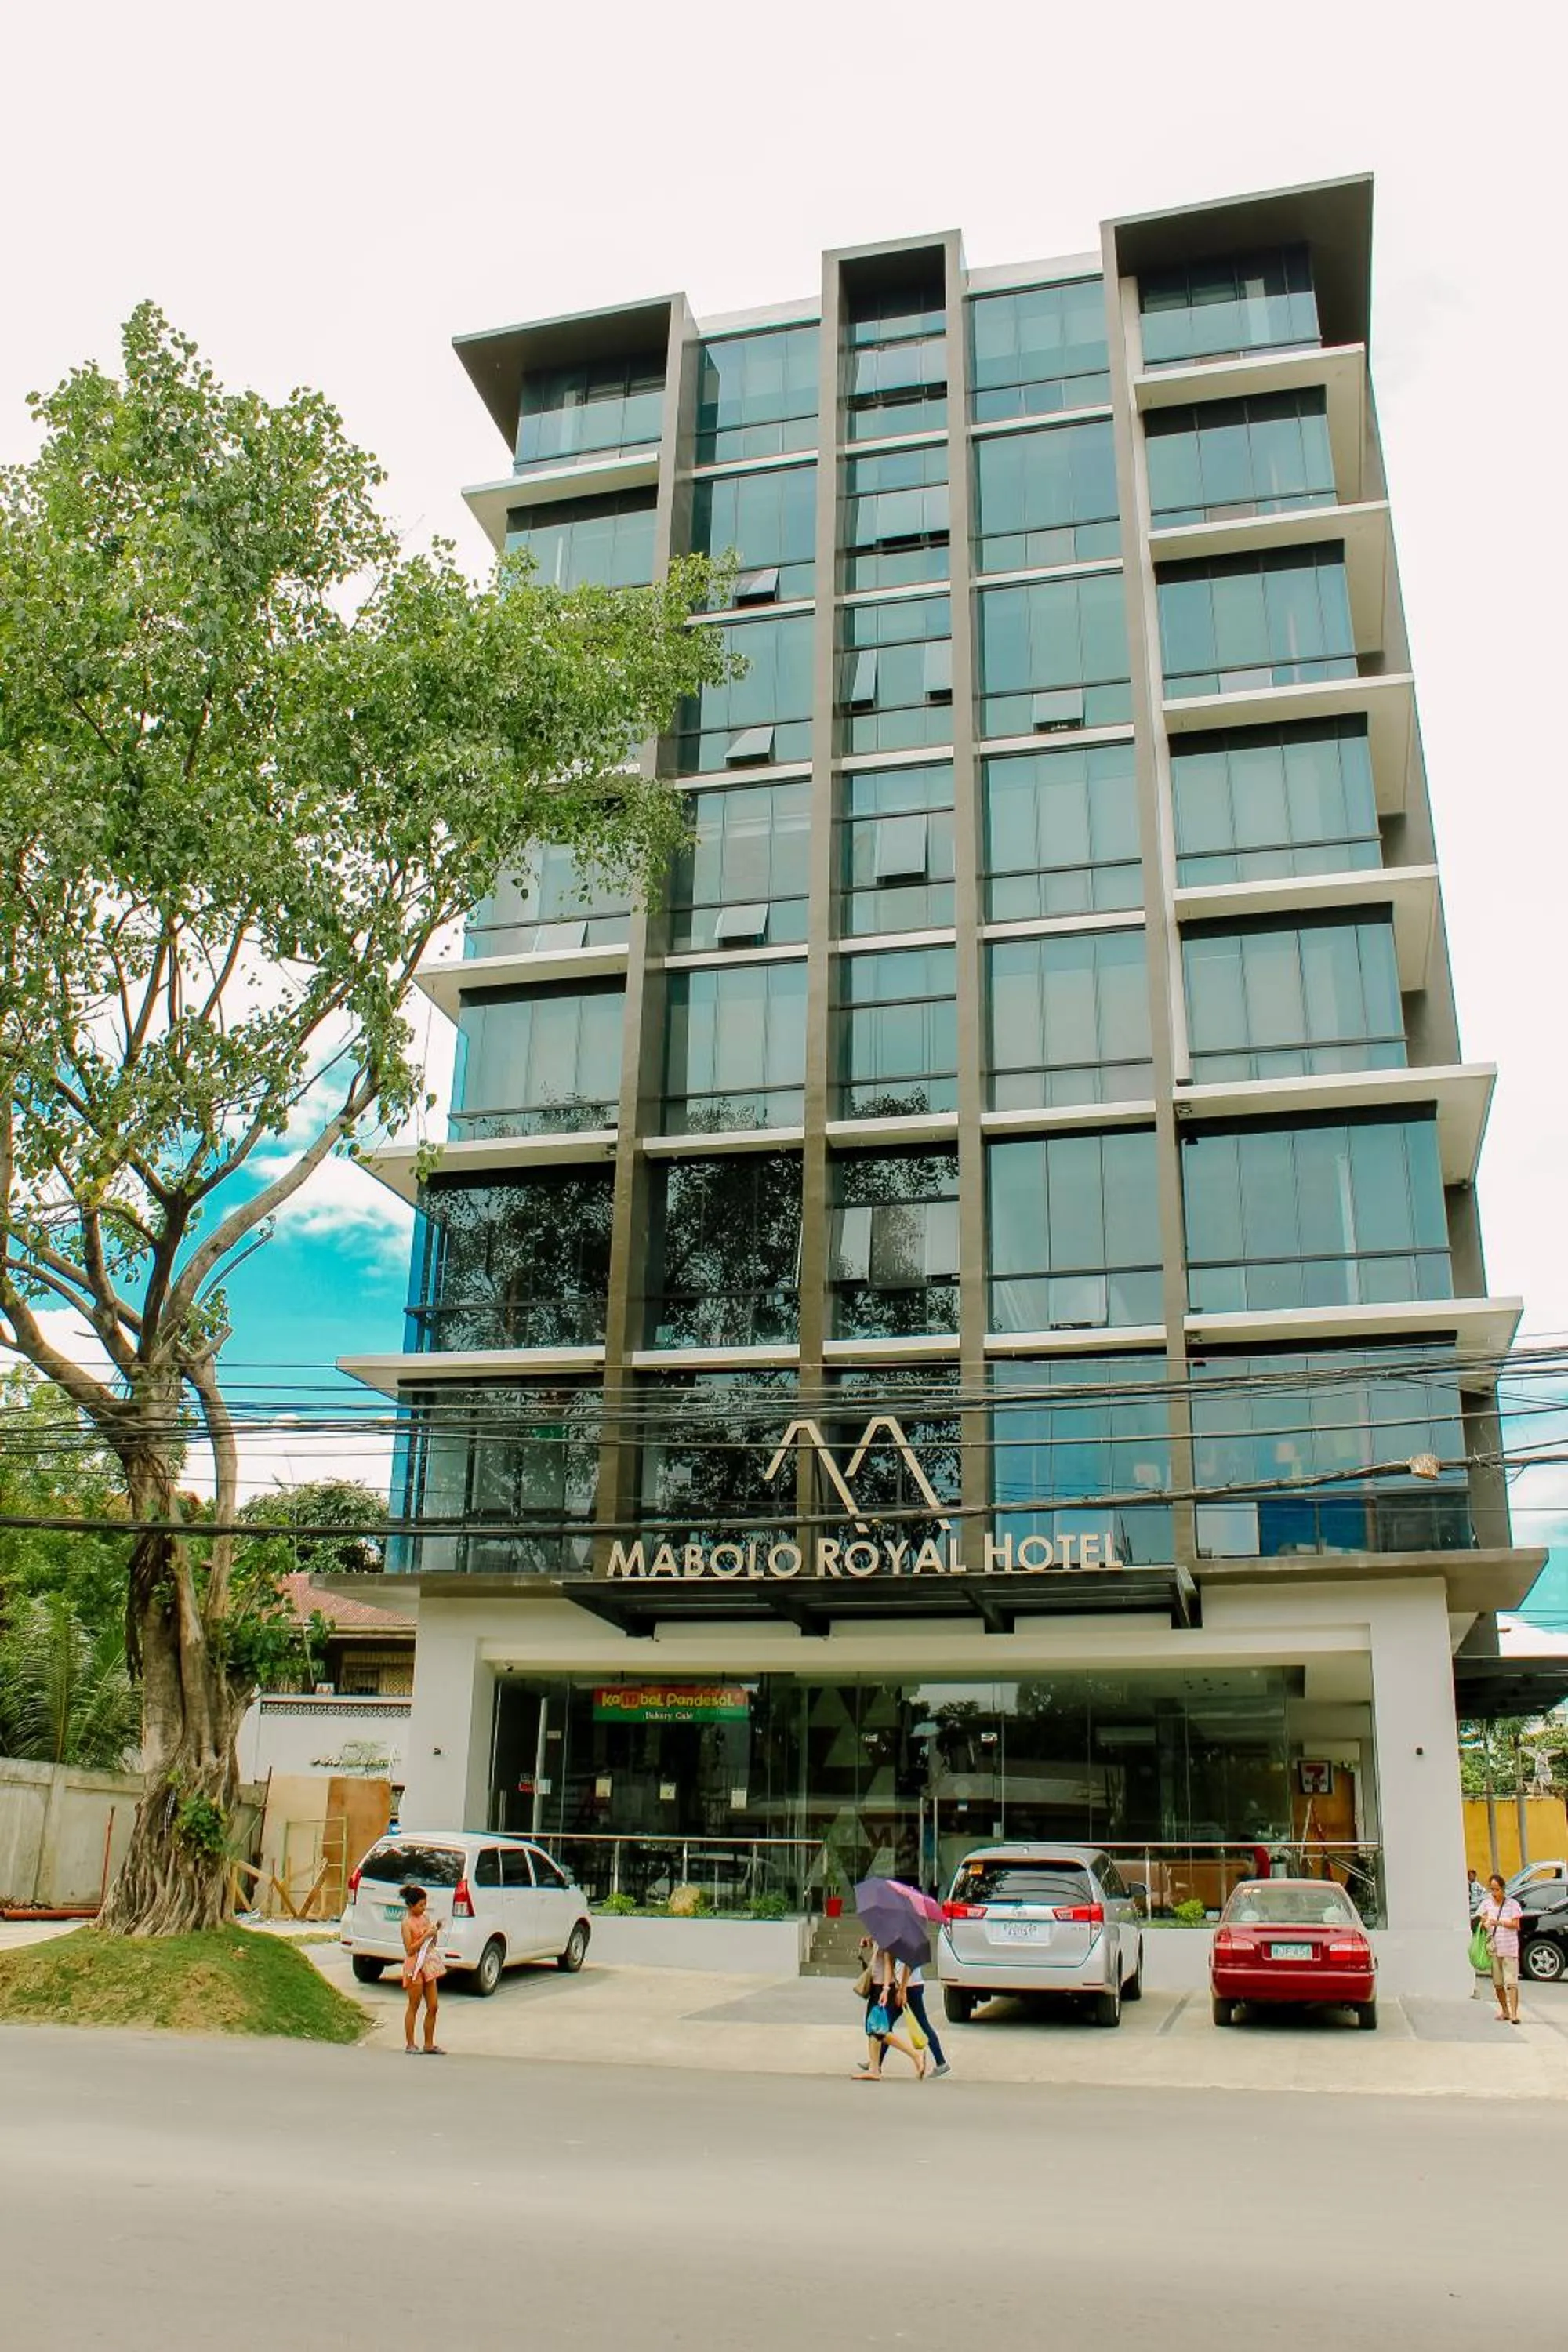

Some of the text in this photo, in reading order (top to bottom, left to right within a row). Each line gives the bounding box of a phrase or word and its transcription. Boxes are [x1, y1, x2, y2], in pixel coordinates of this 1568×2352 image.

[606, 1532, 1123, 1577] MABOLO ROYAL HOTEL
[645, 1711, 673, 1722] Bakery
